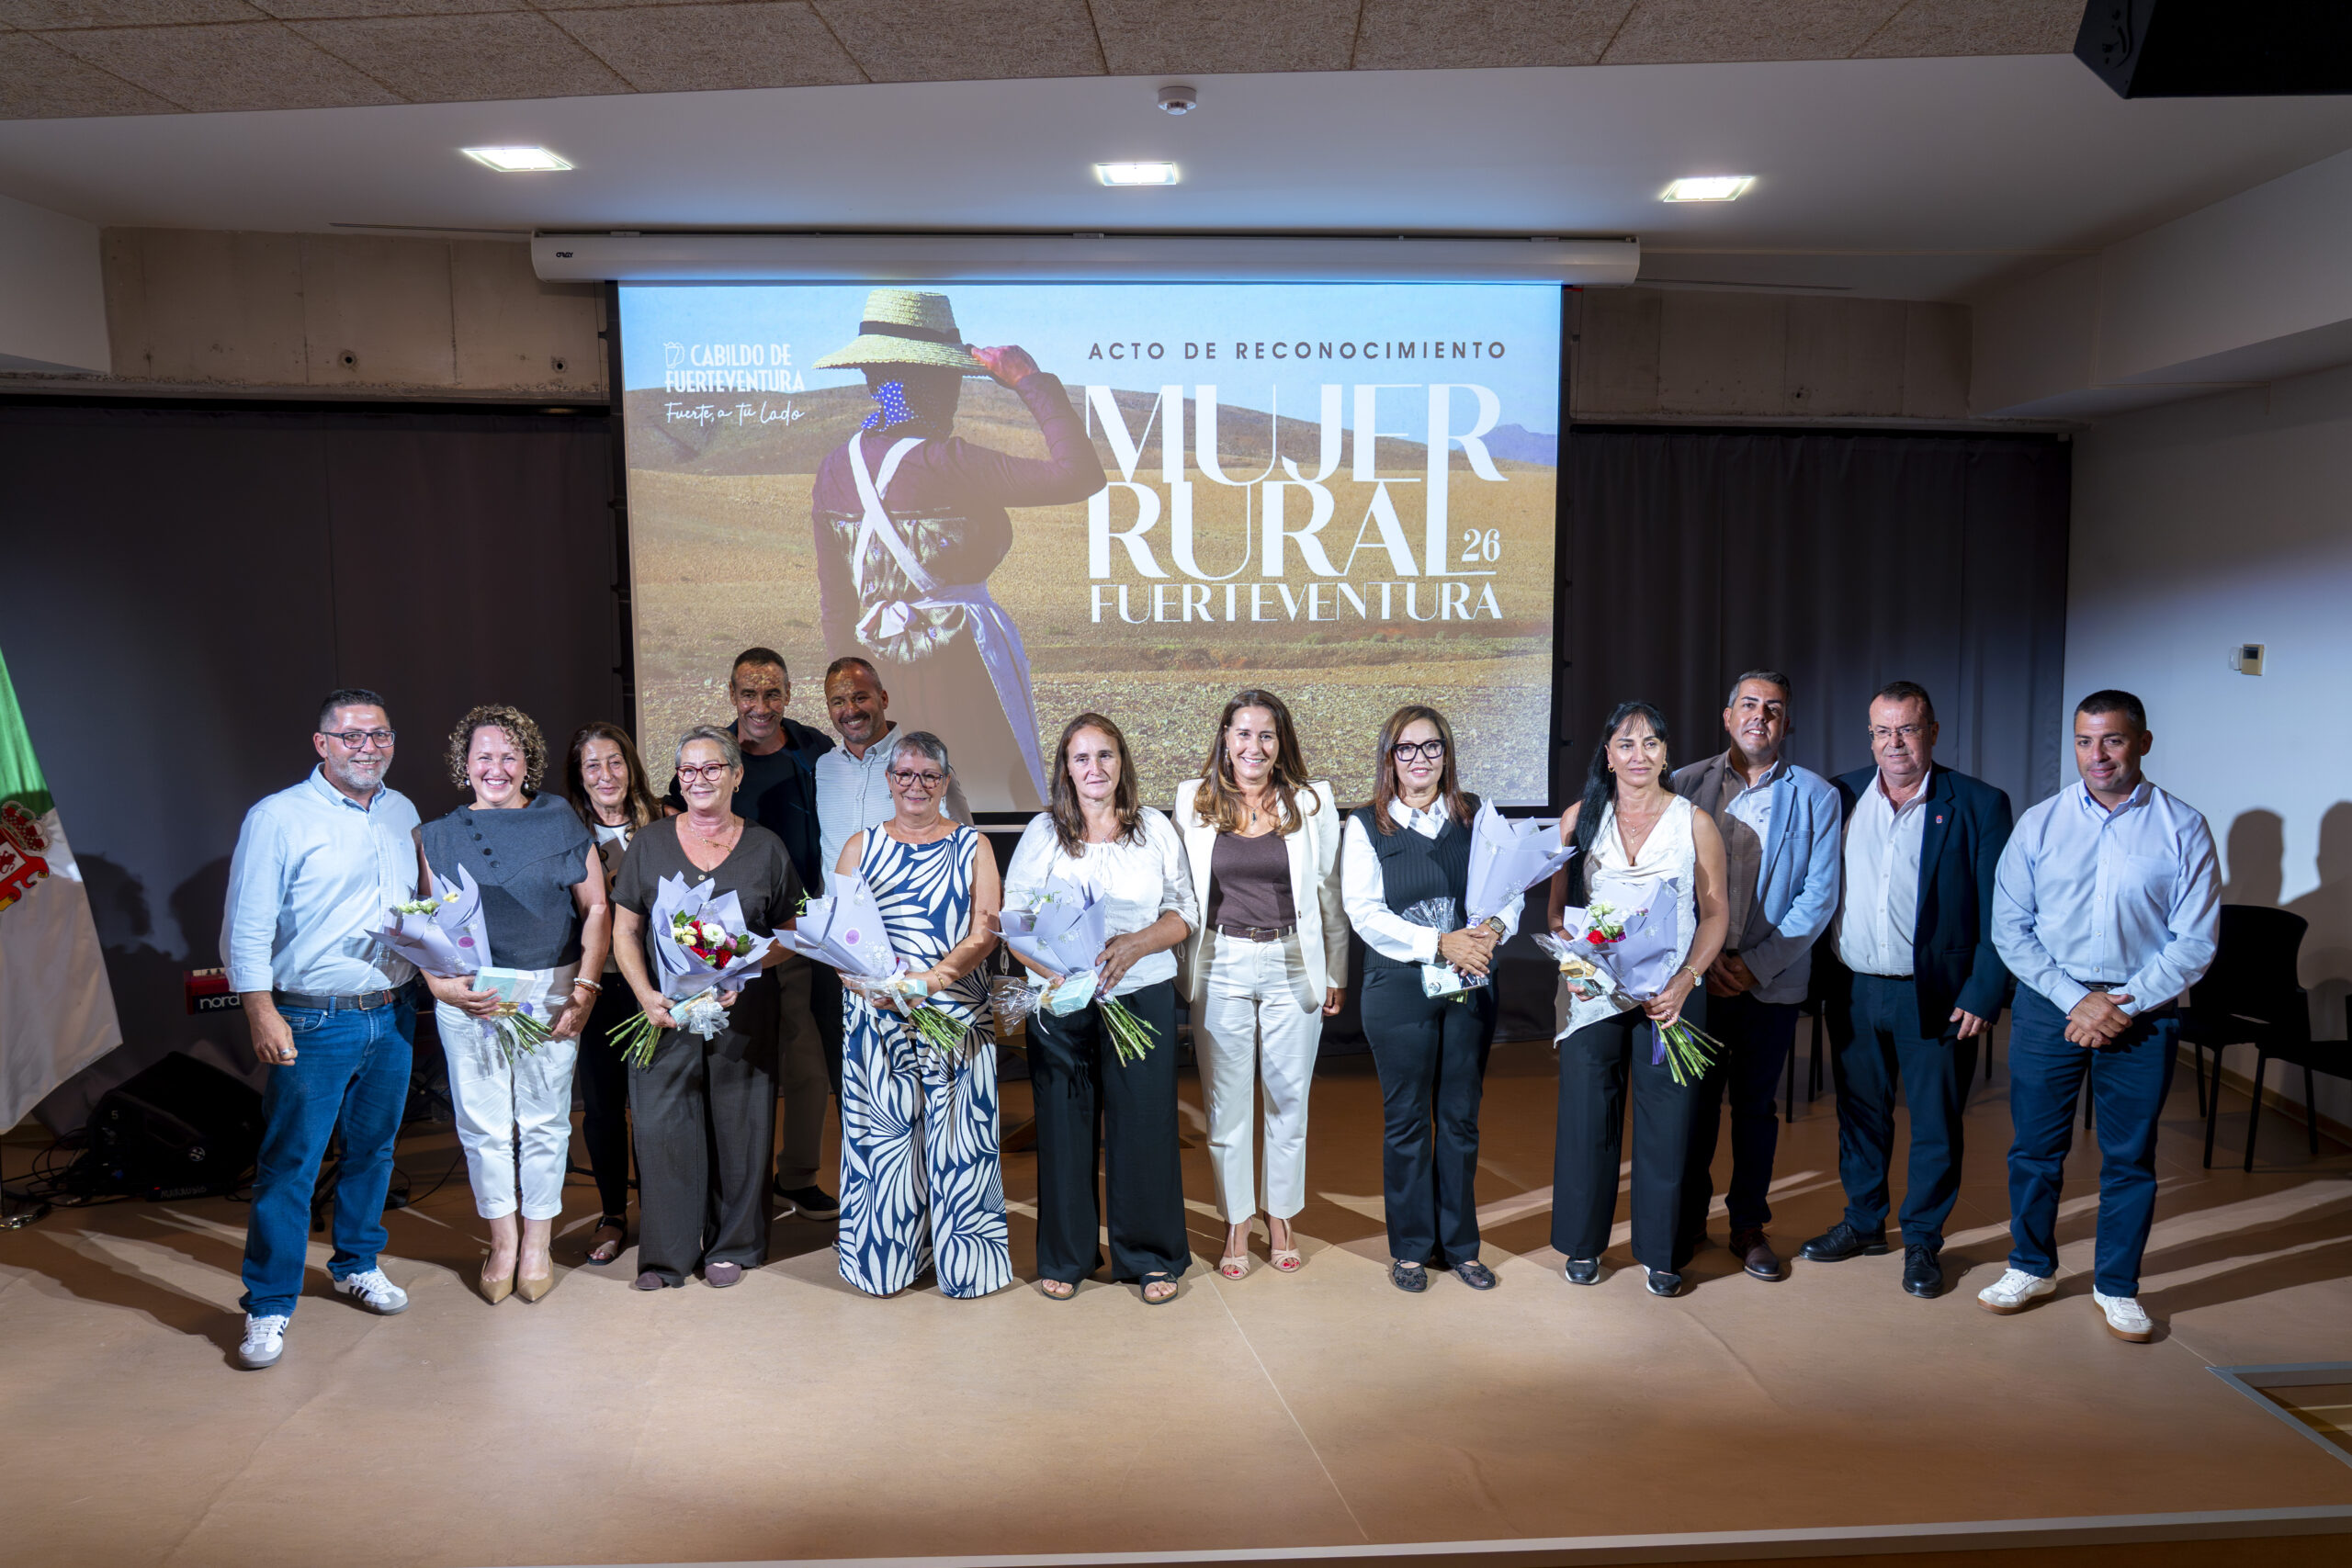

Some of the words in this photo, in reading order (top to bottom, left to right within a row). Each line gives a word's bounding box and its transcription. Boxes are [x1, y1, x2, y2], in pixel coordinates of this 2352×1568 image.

[690, 344, 764, 367] CABILDO
[770, 344, 792, 366] DE
[1088, 343, 1165, 359] ACTO
[1184, 343, 1216, 359] DE
[1236, 341, 1505, 359] RECONOCIMIENTO
[663, 368, 806, 393] FUERTEVENTURA
[663, 401, 714, 426] Fuerte,
[1085, 383, 1510, 486] MUJER
[1088, 480, 1498, 581] RURAL
[1461, 528, 1501, 562] 26
[1091, 581, 1503, 624] FUERTEVENTURA
[199, 992, 241, 1010] nord
